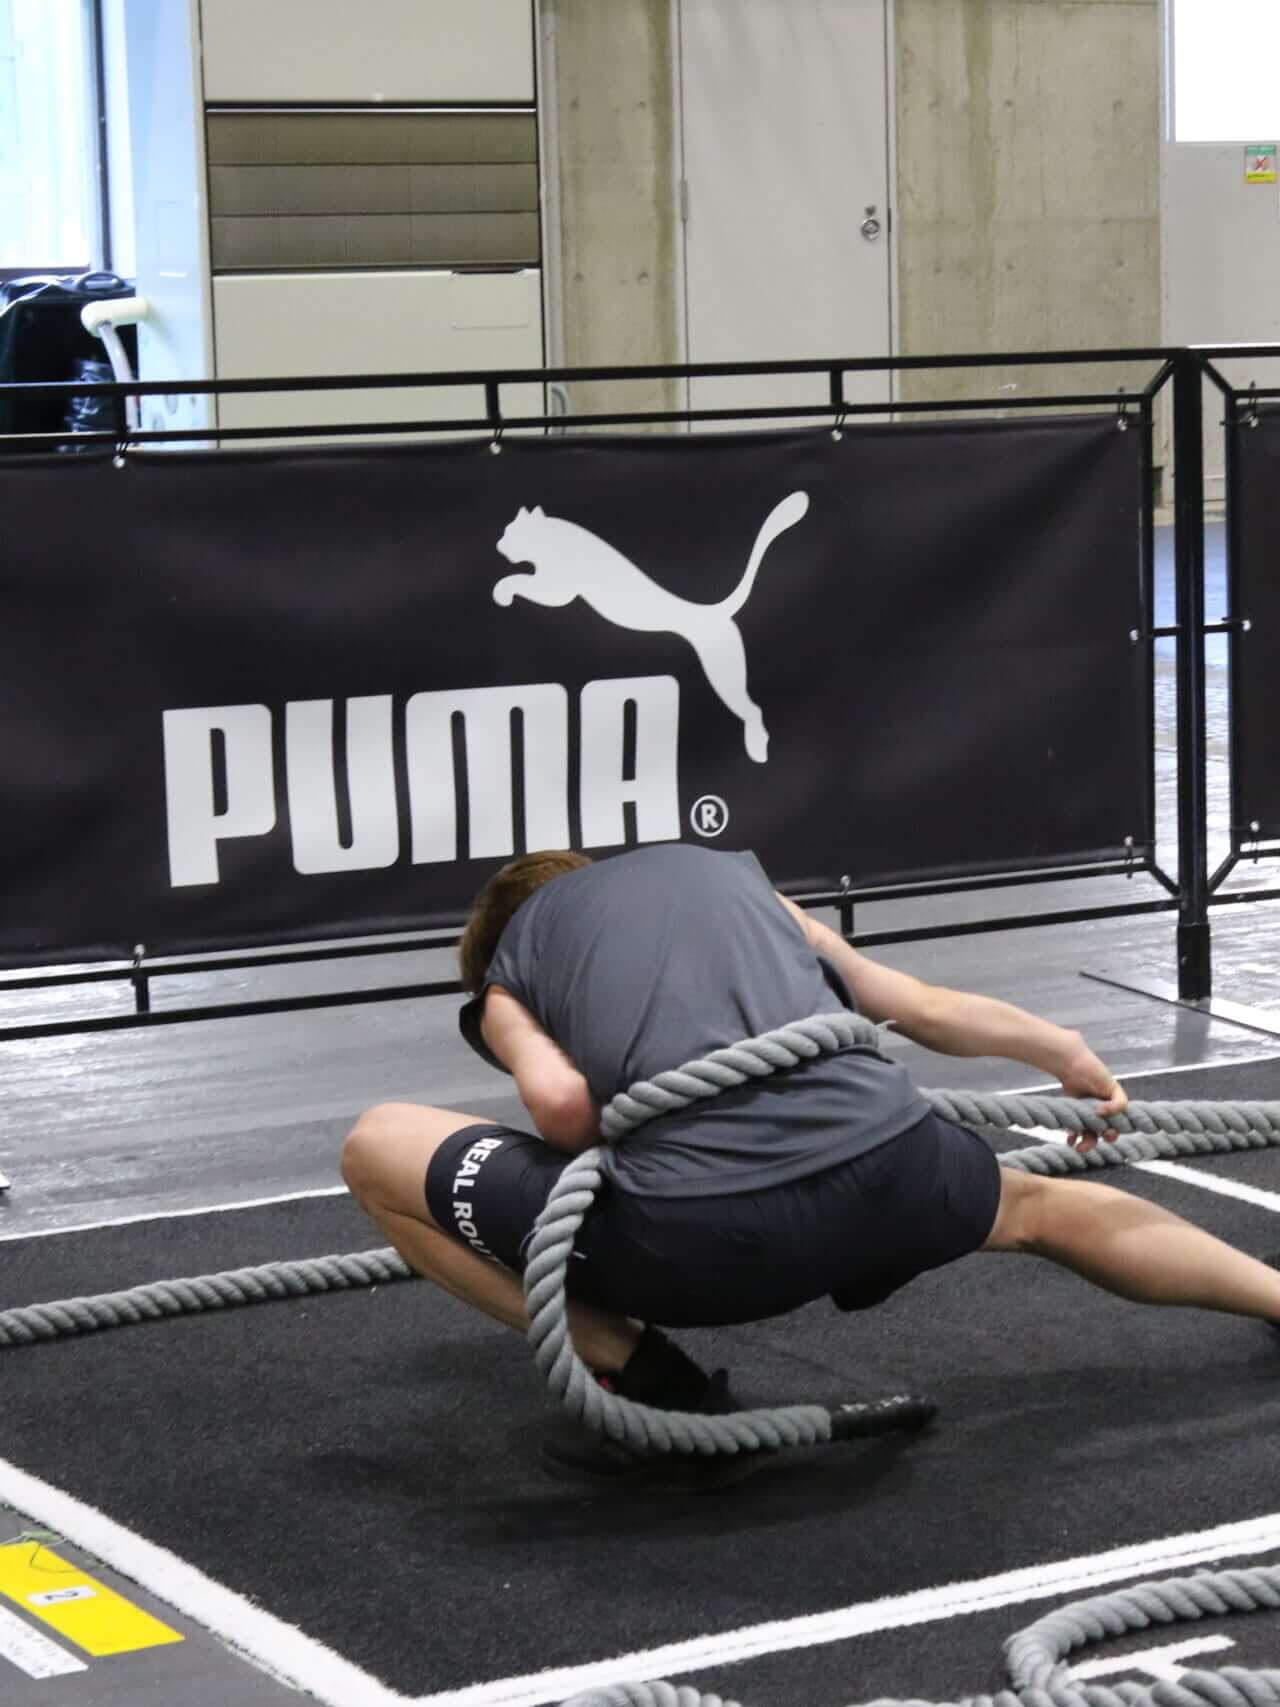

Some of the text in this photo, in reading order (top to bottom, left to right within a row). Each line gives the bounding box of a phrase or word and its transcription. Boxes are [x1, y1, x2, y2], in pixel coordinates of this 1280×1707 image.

[162, 675, 681, 888] PUMA
[452, 1138, 508, 1268] REAL ROU
